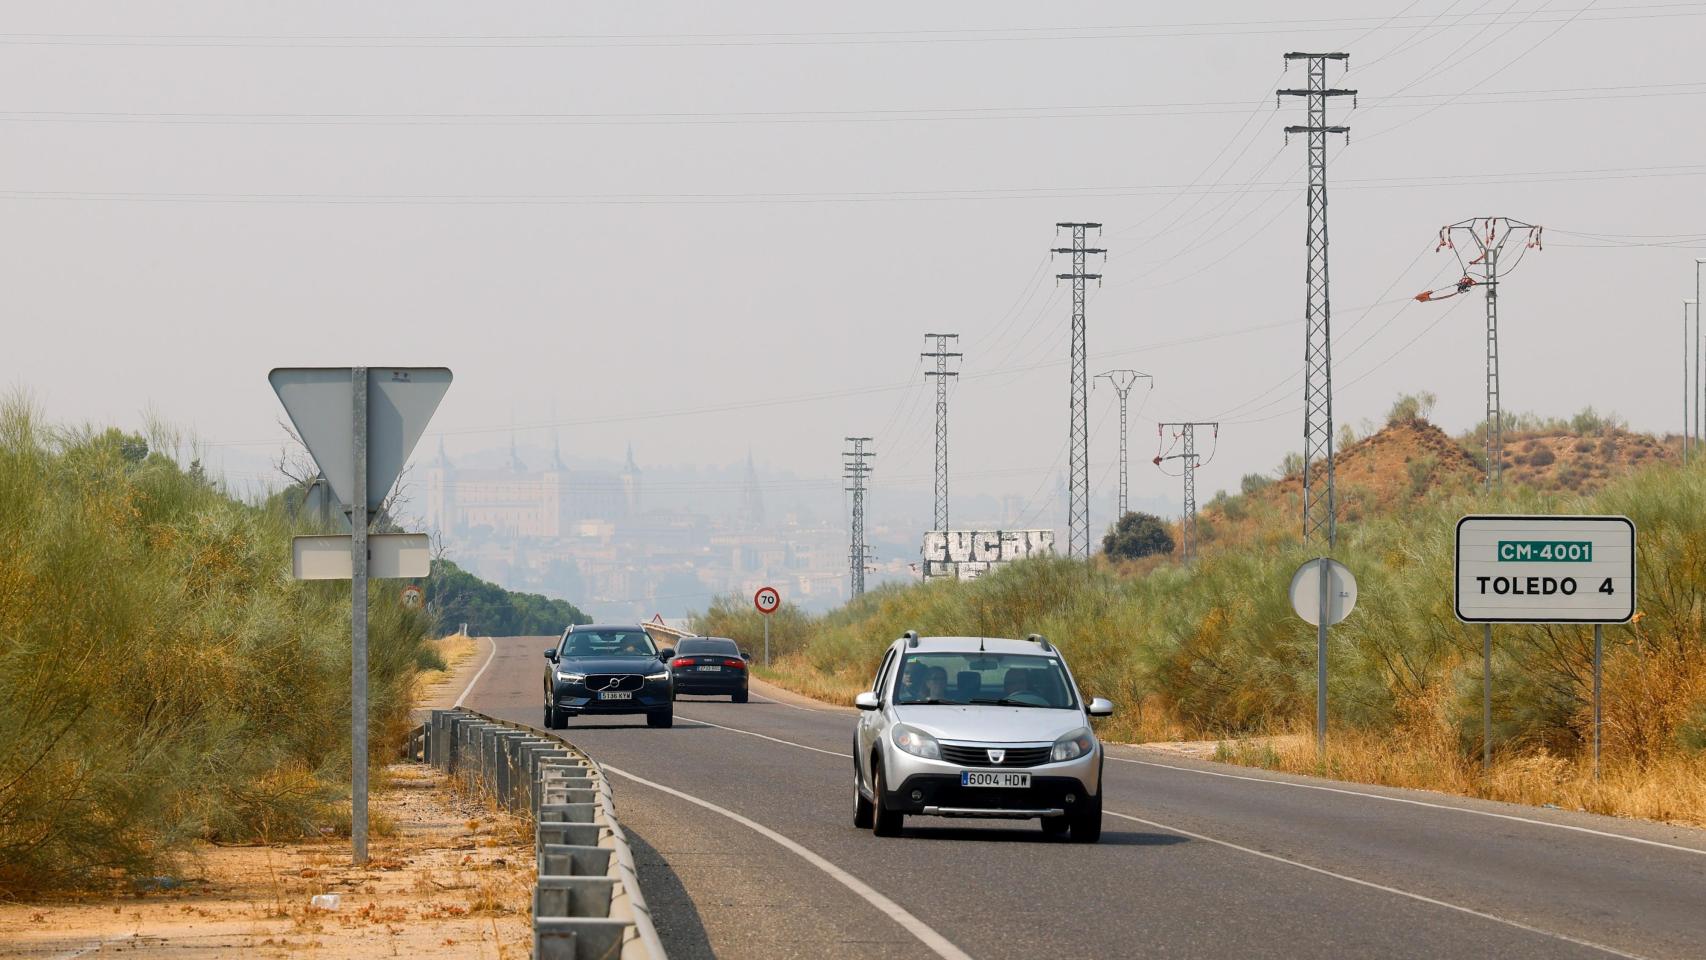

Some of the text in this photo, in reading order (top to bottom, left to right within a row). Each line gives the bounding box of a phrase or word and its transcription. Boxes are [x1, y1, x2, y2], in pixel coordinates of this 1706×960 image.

[1500, 543, 1590, 560] CM-4001
[1476, 576, 1615, 596] TOLEDO 4
[761, 595, 775, 605] 70
[969, 773, 1028, 786] 6004 HDW
